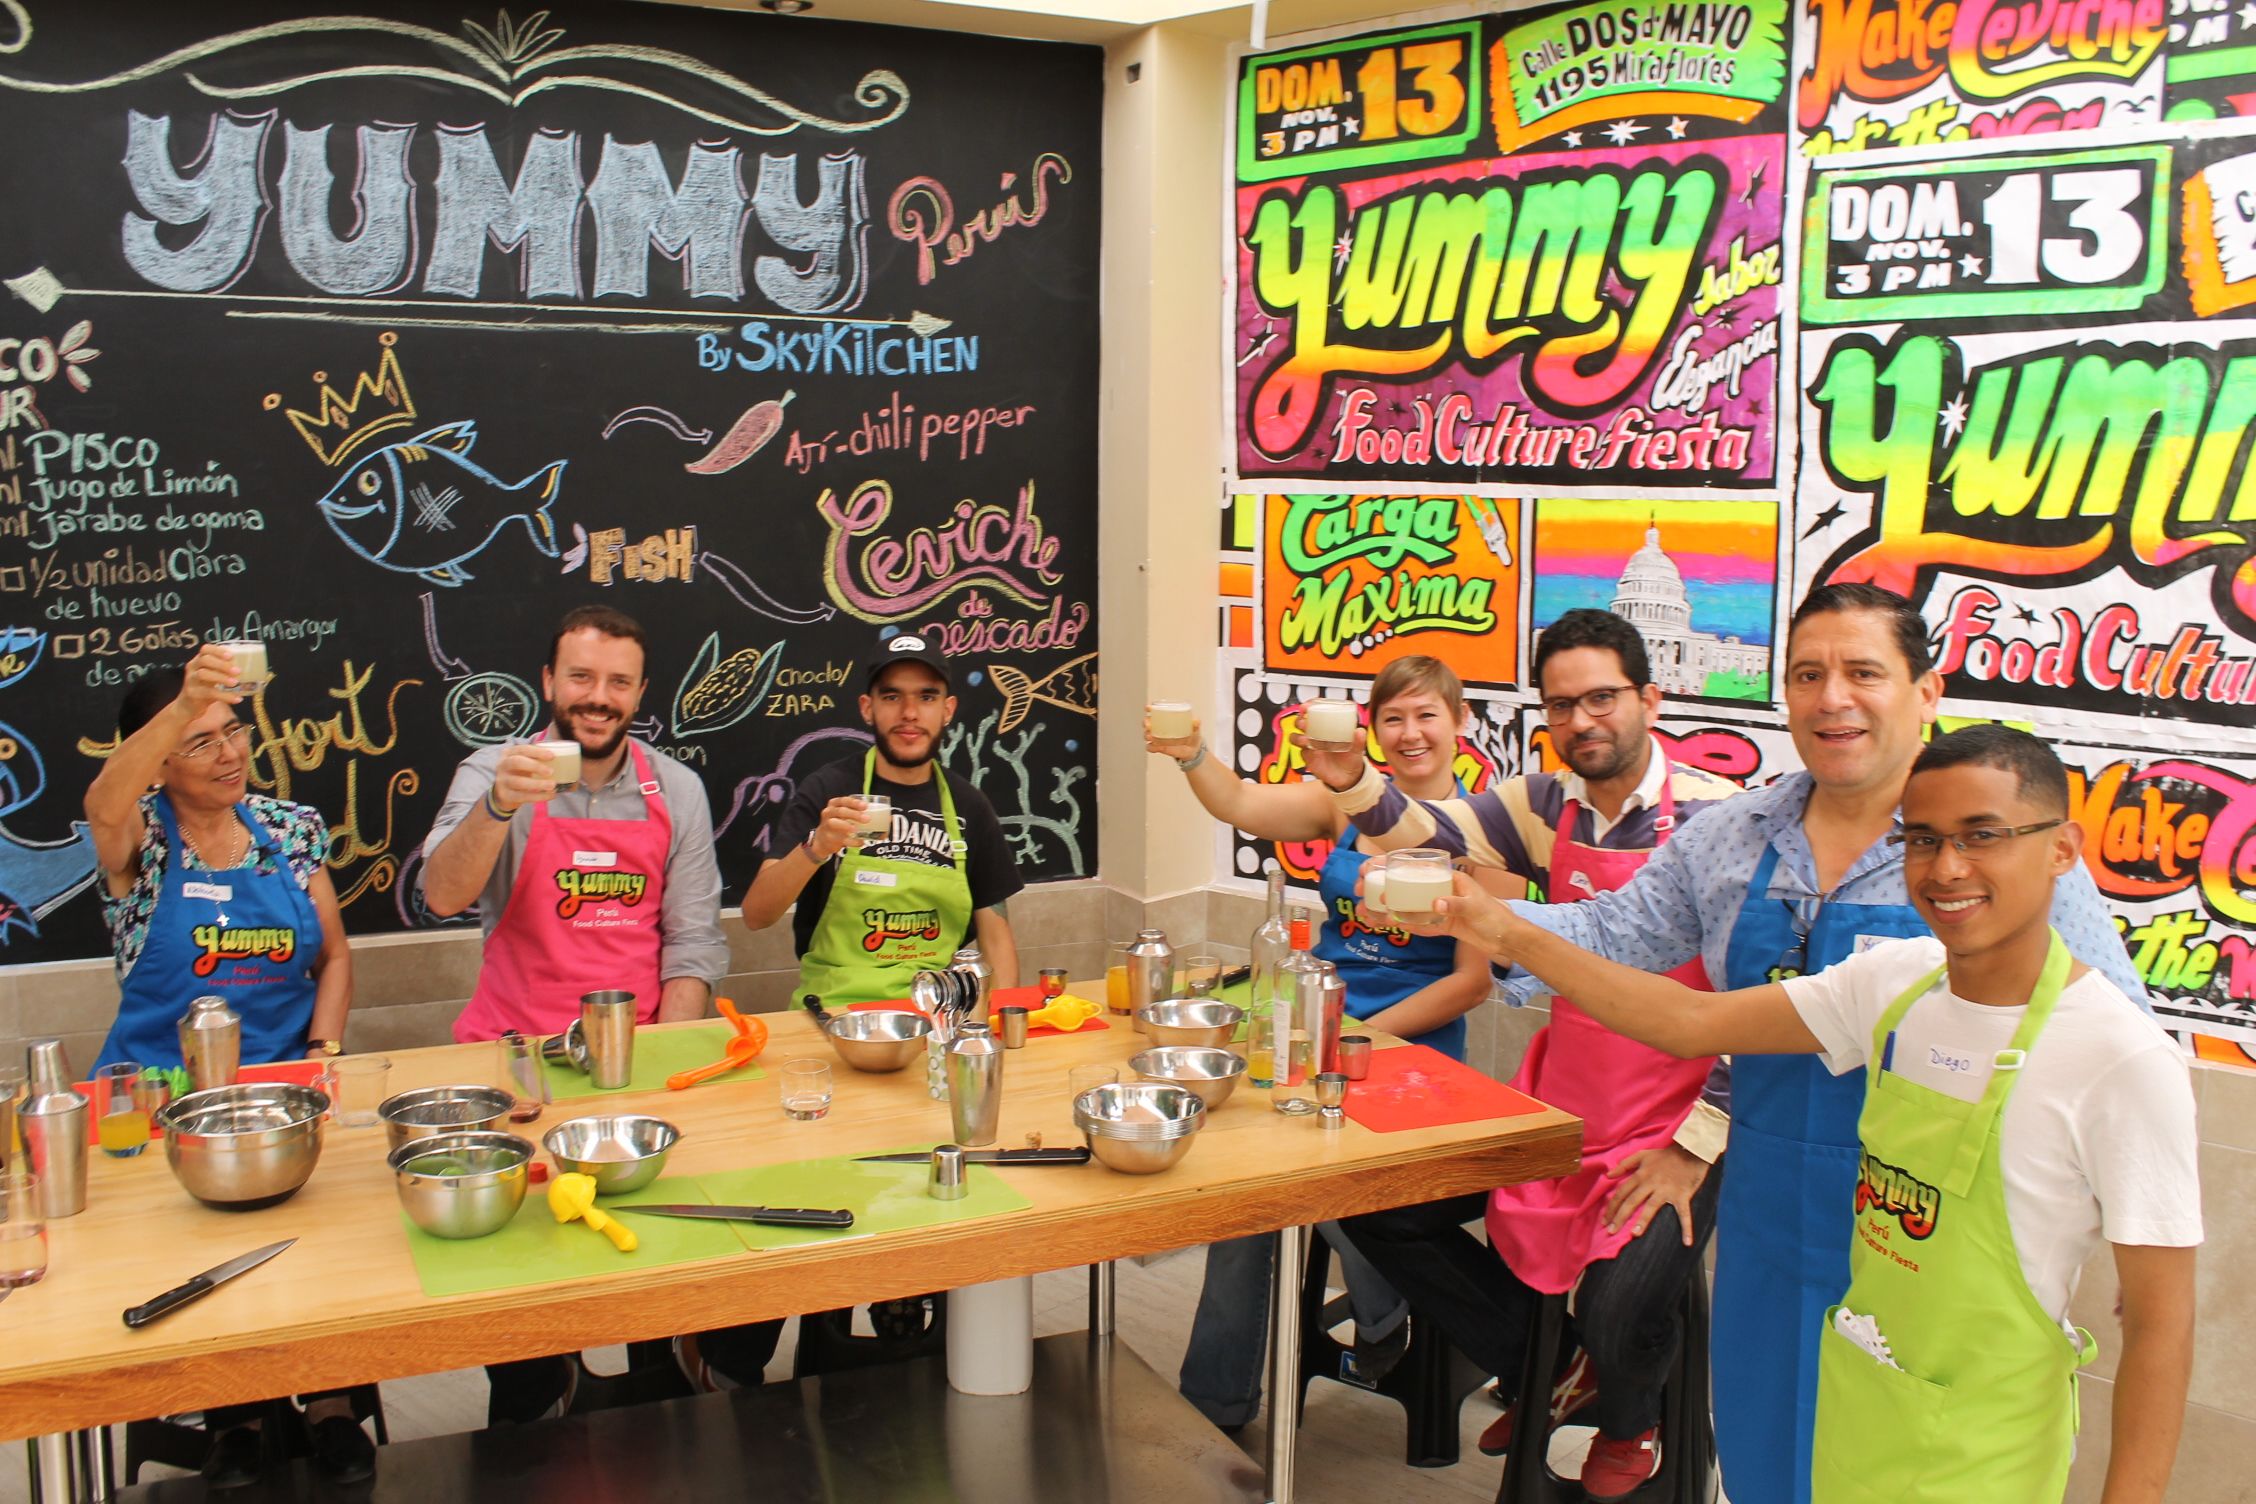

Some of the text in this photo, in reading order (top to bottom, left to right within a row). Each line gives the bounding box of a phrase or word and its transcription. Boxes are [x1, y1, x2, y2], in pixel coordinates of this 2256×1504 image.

[1522, 40, 1568, 78] Calle
[1567, 8, 1638, 57] DOS
[1659, 3, 1753, 50] MAYO
[1798, 0, 1957, 128] Make
[1256, 39, 1465, 142] DOM. 13
[1535, 48, 1737, 108] 1195 Miraflores
[1260, 125, 1339, 156] 3 PM
[1280, 107, 1338, 128] NOV.
[122, 107, 872, 314] YUMMY
[1831, 180, 1974, 242] DOM.
[1983, 168, 2144, 284] 13
[1865, 239, 1951, 262] NOV.
[1836, 263, 1952, 295] 3 PM
[1249, 169, 1717, 455] Yummy
[696, 332, 731, 372] By
[918, 404, 1037, 462] pepper
[1331, 388, 1434, 466] Food
[1434, 393, 1598, 468] Culture
[109, 471, 140, 498] de
[155, 503, 190, 532] de
[187, 508, 265, 553] goma
[816, 478, 1064, 624] Ceviche
[1281, 494, 1460, 573] Carga
[72, 545, 167, 588] unidad
[45, 587, 182, 620] de huevo
[1281, 568, 1496, 655] Maxima
[88, 628, 120, 656] 2
[204, 616, 242, 644] de
[1931, 586, 2256, 705] Food Cultu
[86, 660, 122, 687] de
[876, 844, 932, 858] OLD TIME
[555, 869, 647, 920] Yummy
[191, 924, 296, 978] Yummy
[863, 908, 941, 952] Yummy
[1931, 1047, 1971, 1071] Diego
